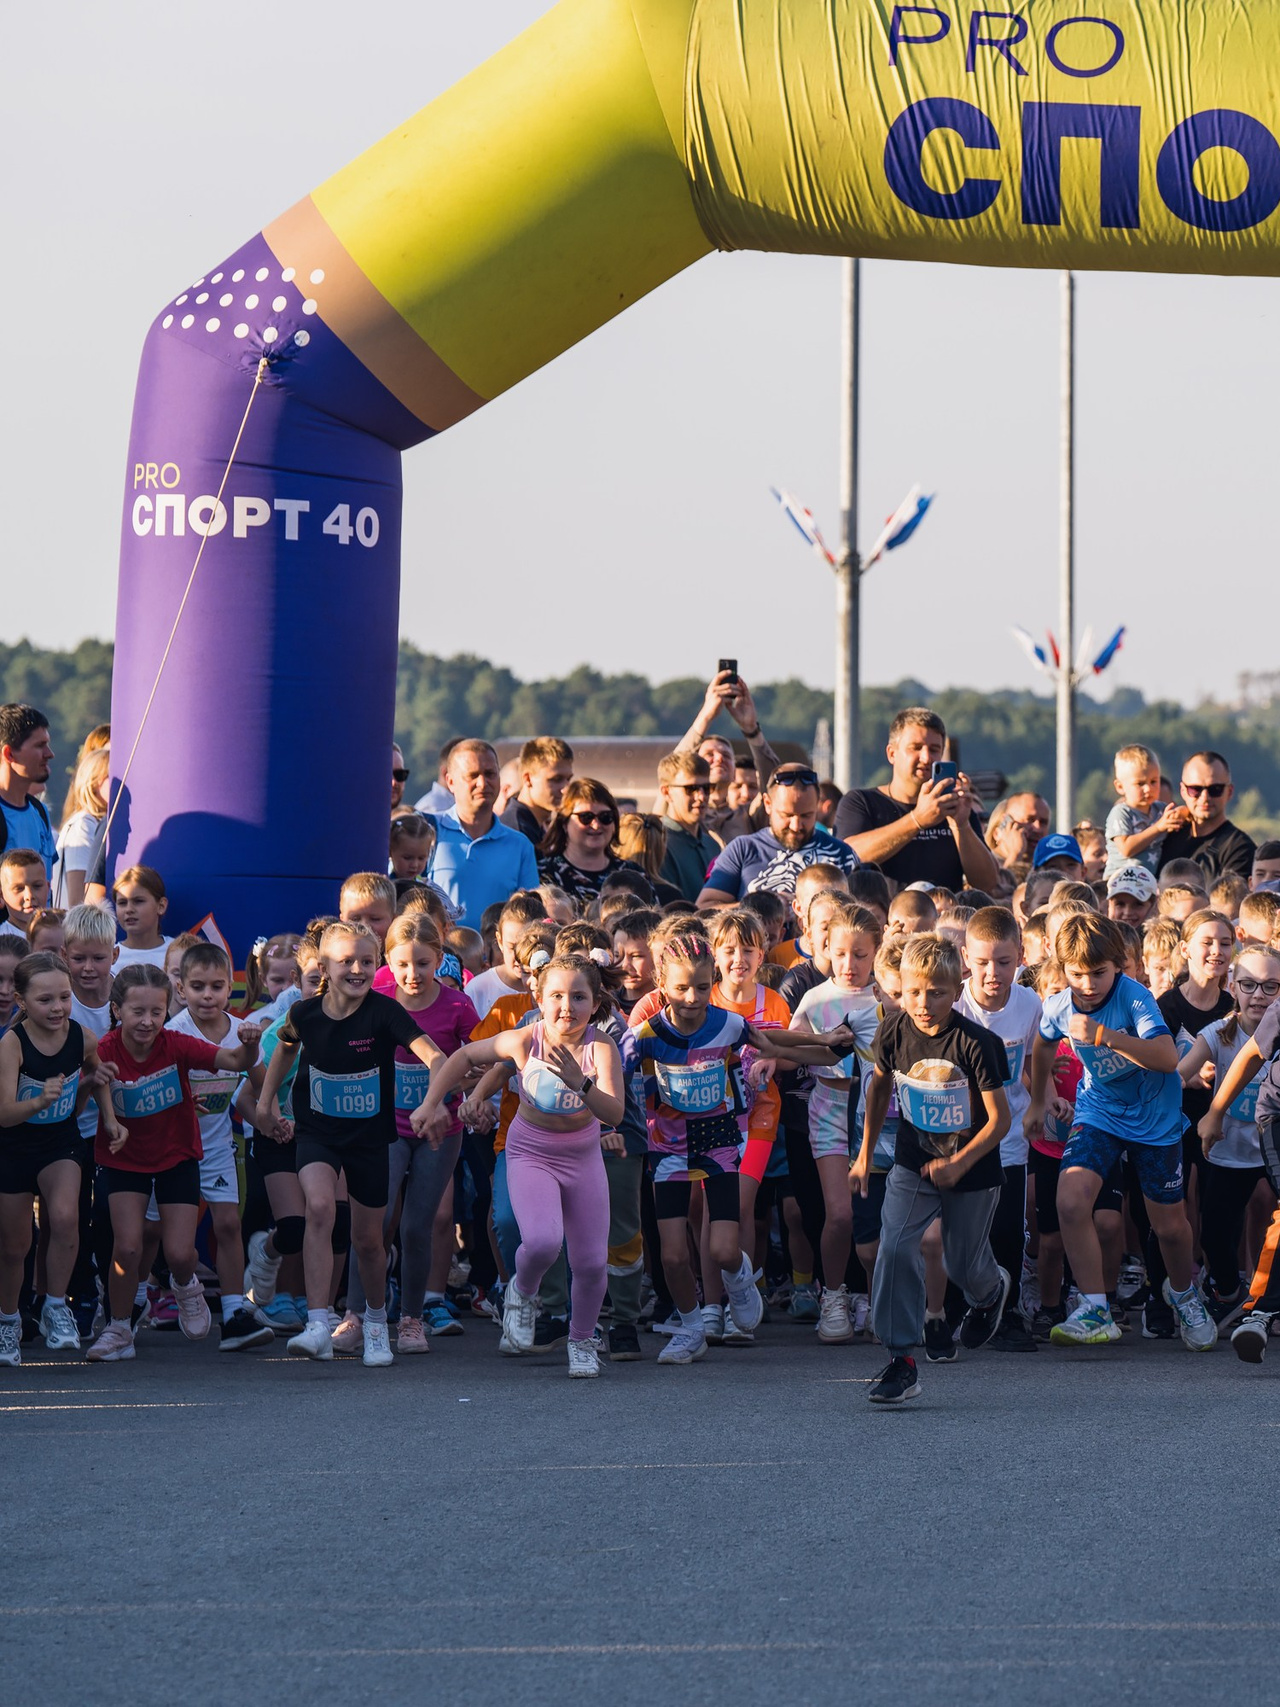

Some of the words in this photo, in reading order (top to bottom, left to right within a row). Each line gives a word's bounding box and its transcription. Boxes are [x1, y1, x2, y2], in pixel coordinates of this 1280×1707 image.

[887, 4, 1124, 79] PRO
[134, 462, 181, 490] PRO
[132, 494, 310, 541] СПОРТ
[322, 503, 380, 548] 40
[919, 828, 953, 836] HILFIGE
[142, 1081, 164, 1096] АРИНА
[344, 1085, 362, 1094] ВЕРА
[402, 1075, 429, 1084] ЕКАТЕР
[678, 1073, 719, 1087] АНАСТАСИЯ
[134, 1087, 176, 1113] 4319
[334, 1093, 375, 1113] 1099
[679, 1084, 720, 1107] 4496
[923, 1094, 956, 1104] ЛЕОНИД
[920, 1105, 964, 1127] 1245
